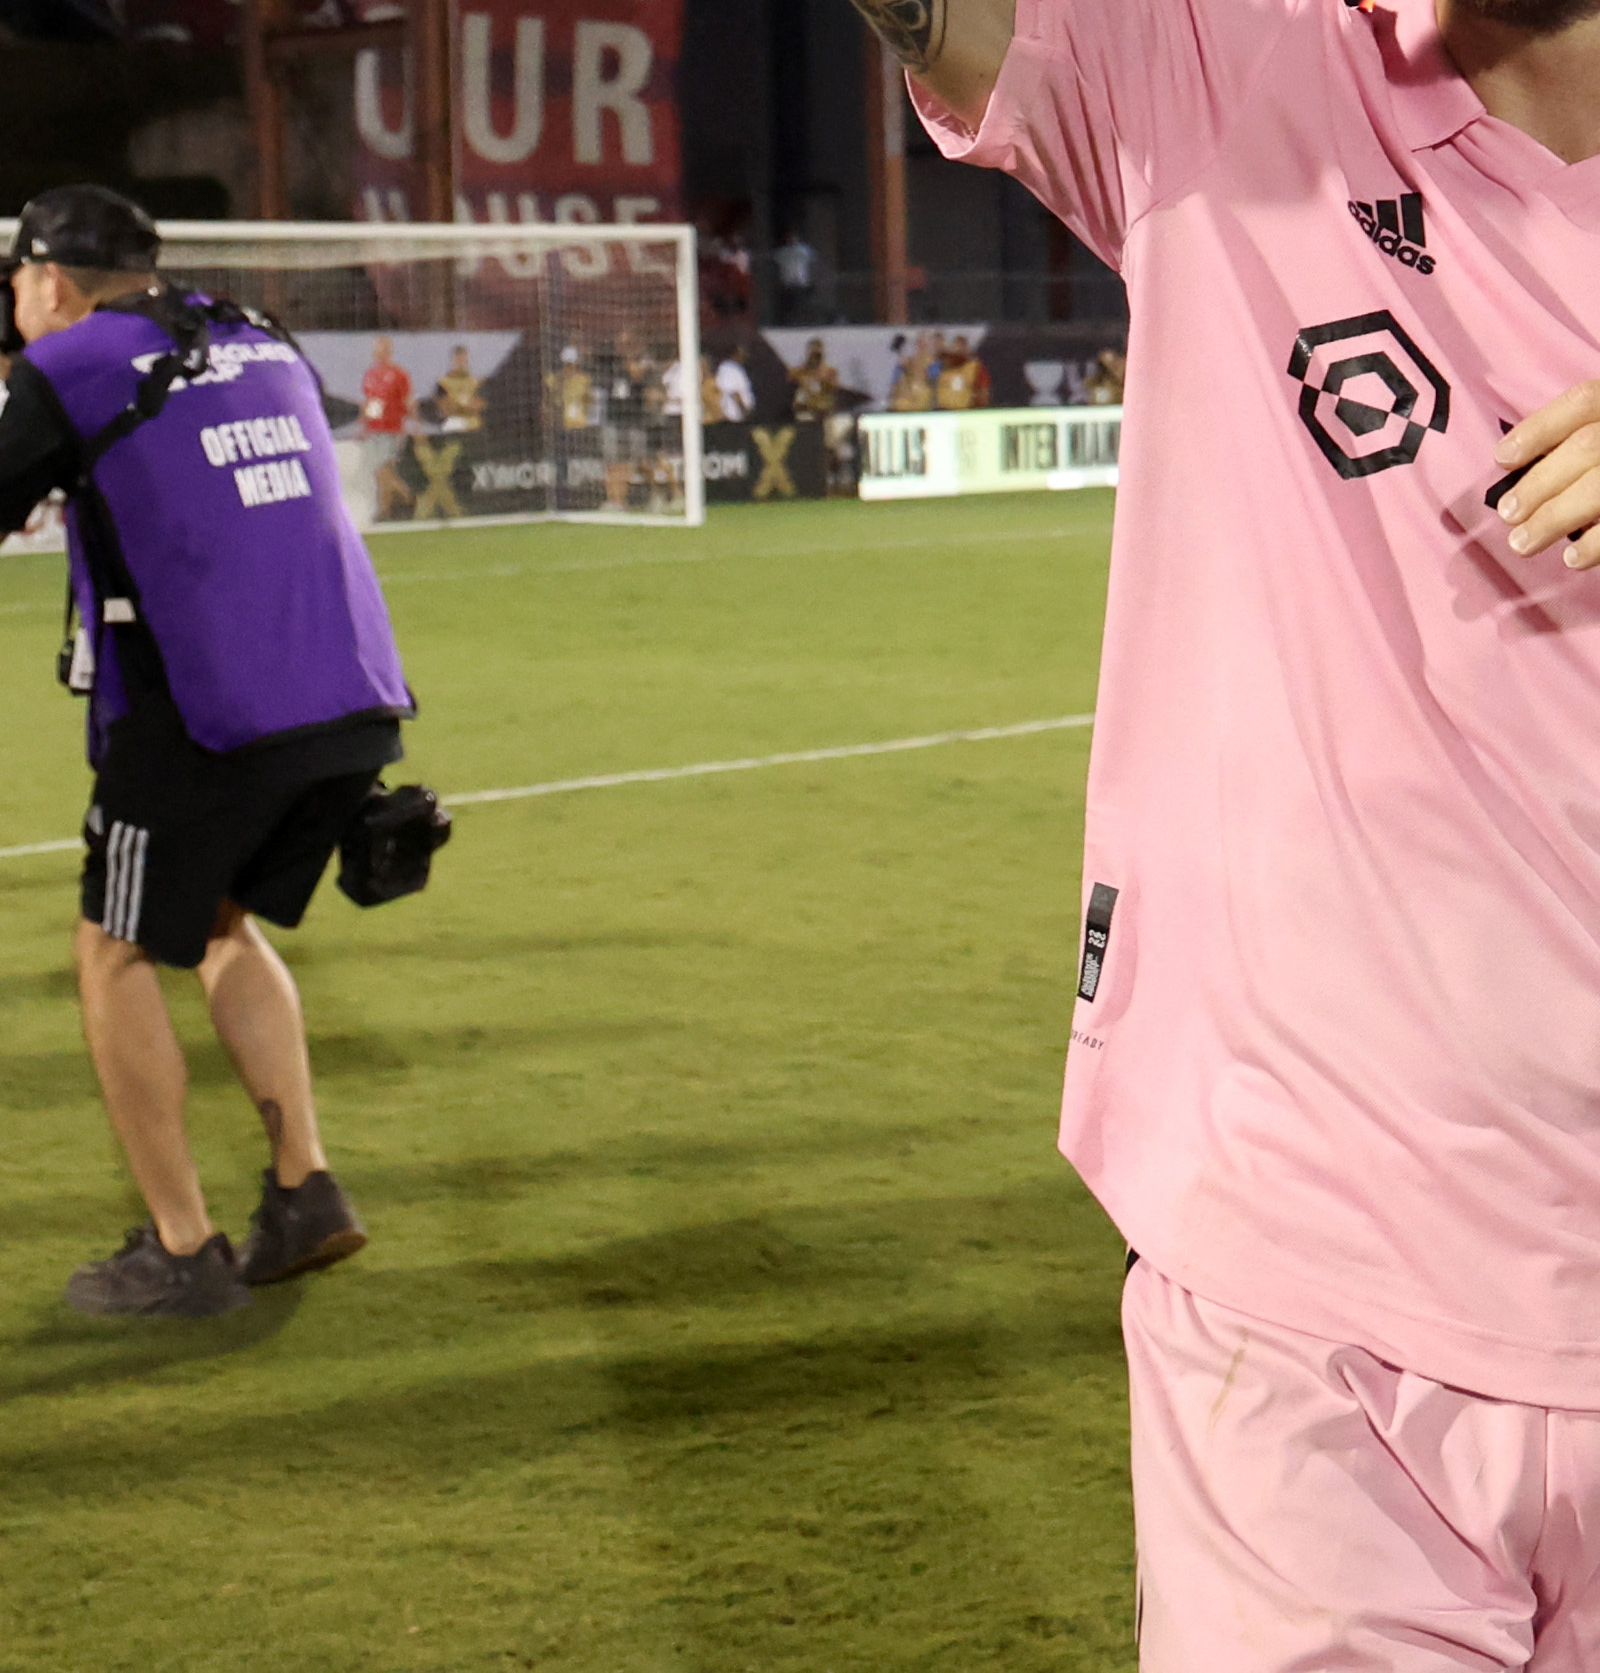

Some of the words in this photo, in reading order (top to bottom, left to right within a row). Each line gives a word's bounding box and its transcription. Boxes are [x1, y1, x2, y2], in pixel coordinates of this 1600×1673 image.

[1347, 200, 1437, 276] adidas
[200, 415, 312, 468] OFFICIAL
[233, 458, 312, 508] MEDIA
